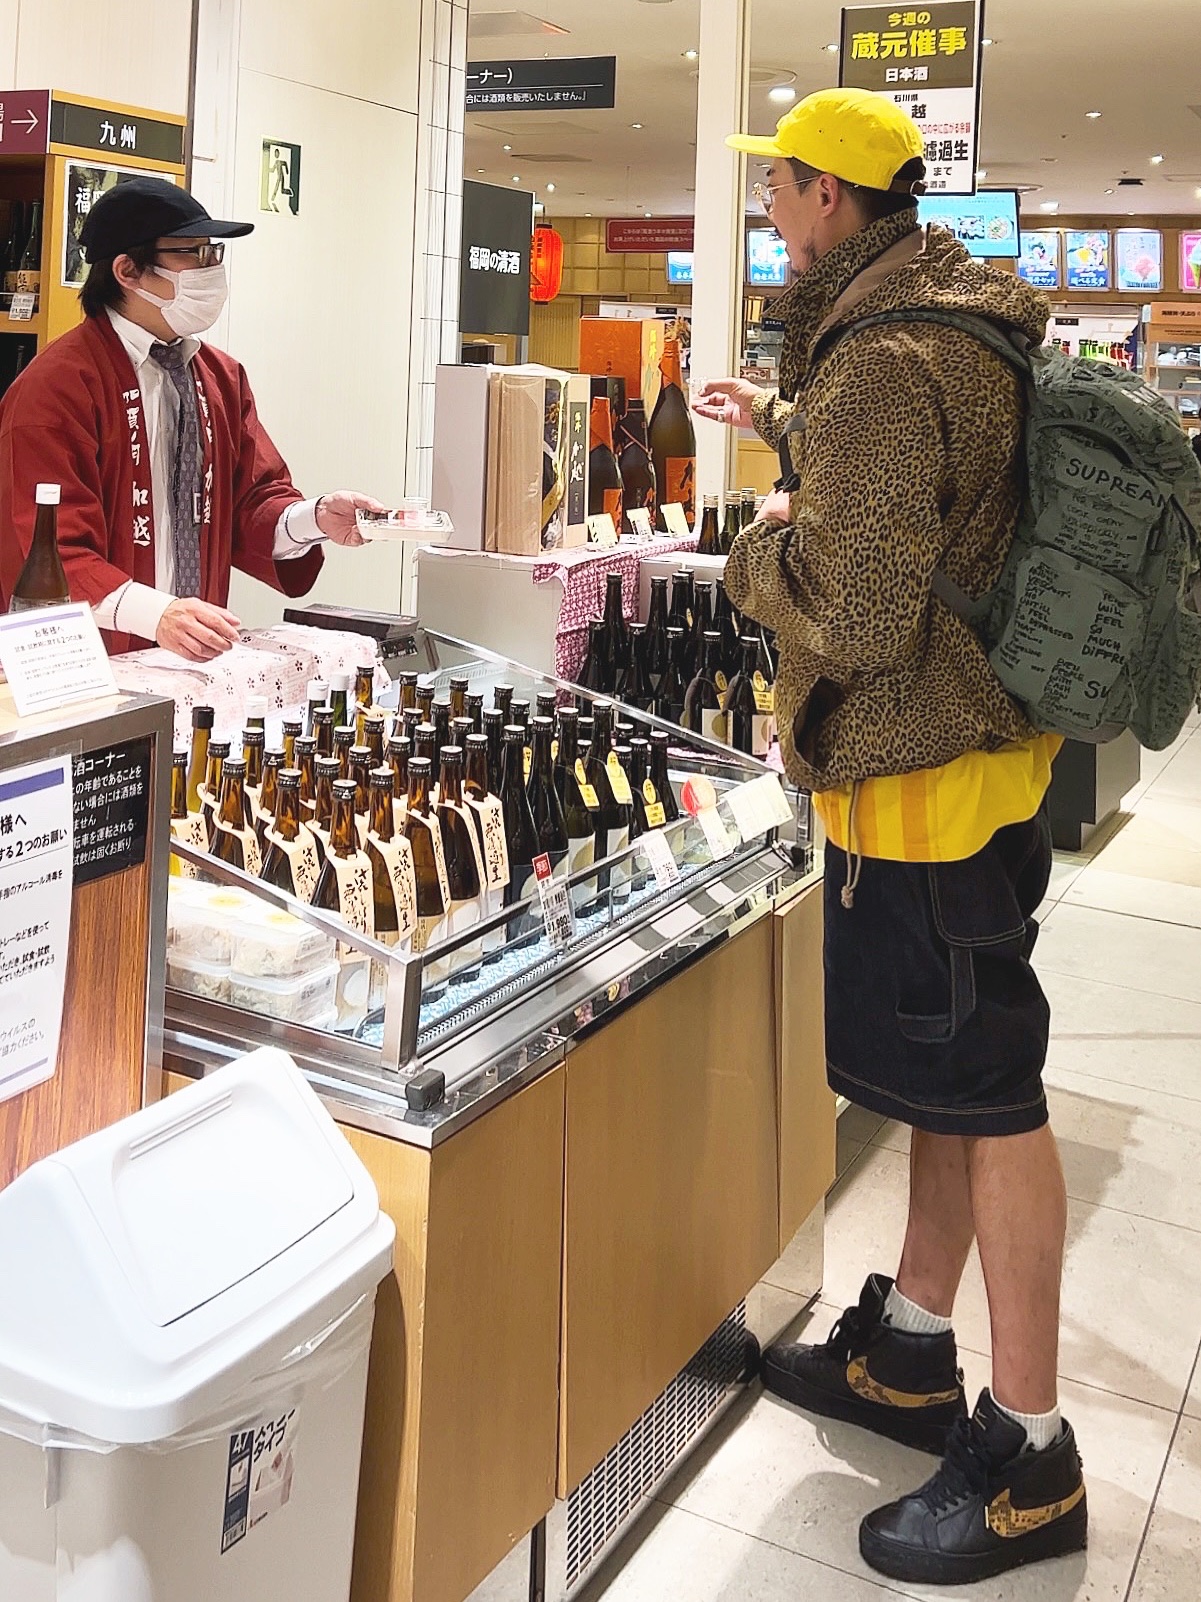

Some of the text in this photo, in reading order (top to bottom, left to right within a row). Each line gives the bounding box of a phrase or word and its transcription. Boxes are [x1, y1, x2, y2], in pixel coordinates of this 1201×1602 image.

[888, 11, 931, 27] 今週の
[851, 27, 968, 60] 蔵元催事
[885, 66, 929, 83] 日本酒
[893, 93, 919, 103] 石川県
[99, 120, 137, 150] 九州
[933, 166, 953, 176] まで
[468, 246, 522, 275] 福岡の清酒
[1089, 623, 1103, 635] SO
[1094, 613, 1125, 629] FEEL
[1086, 635, 1121, 652] MUCH
[0, 813, 27, 837] 様へ
